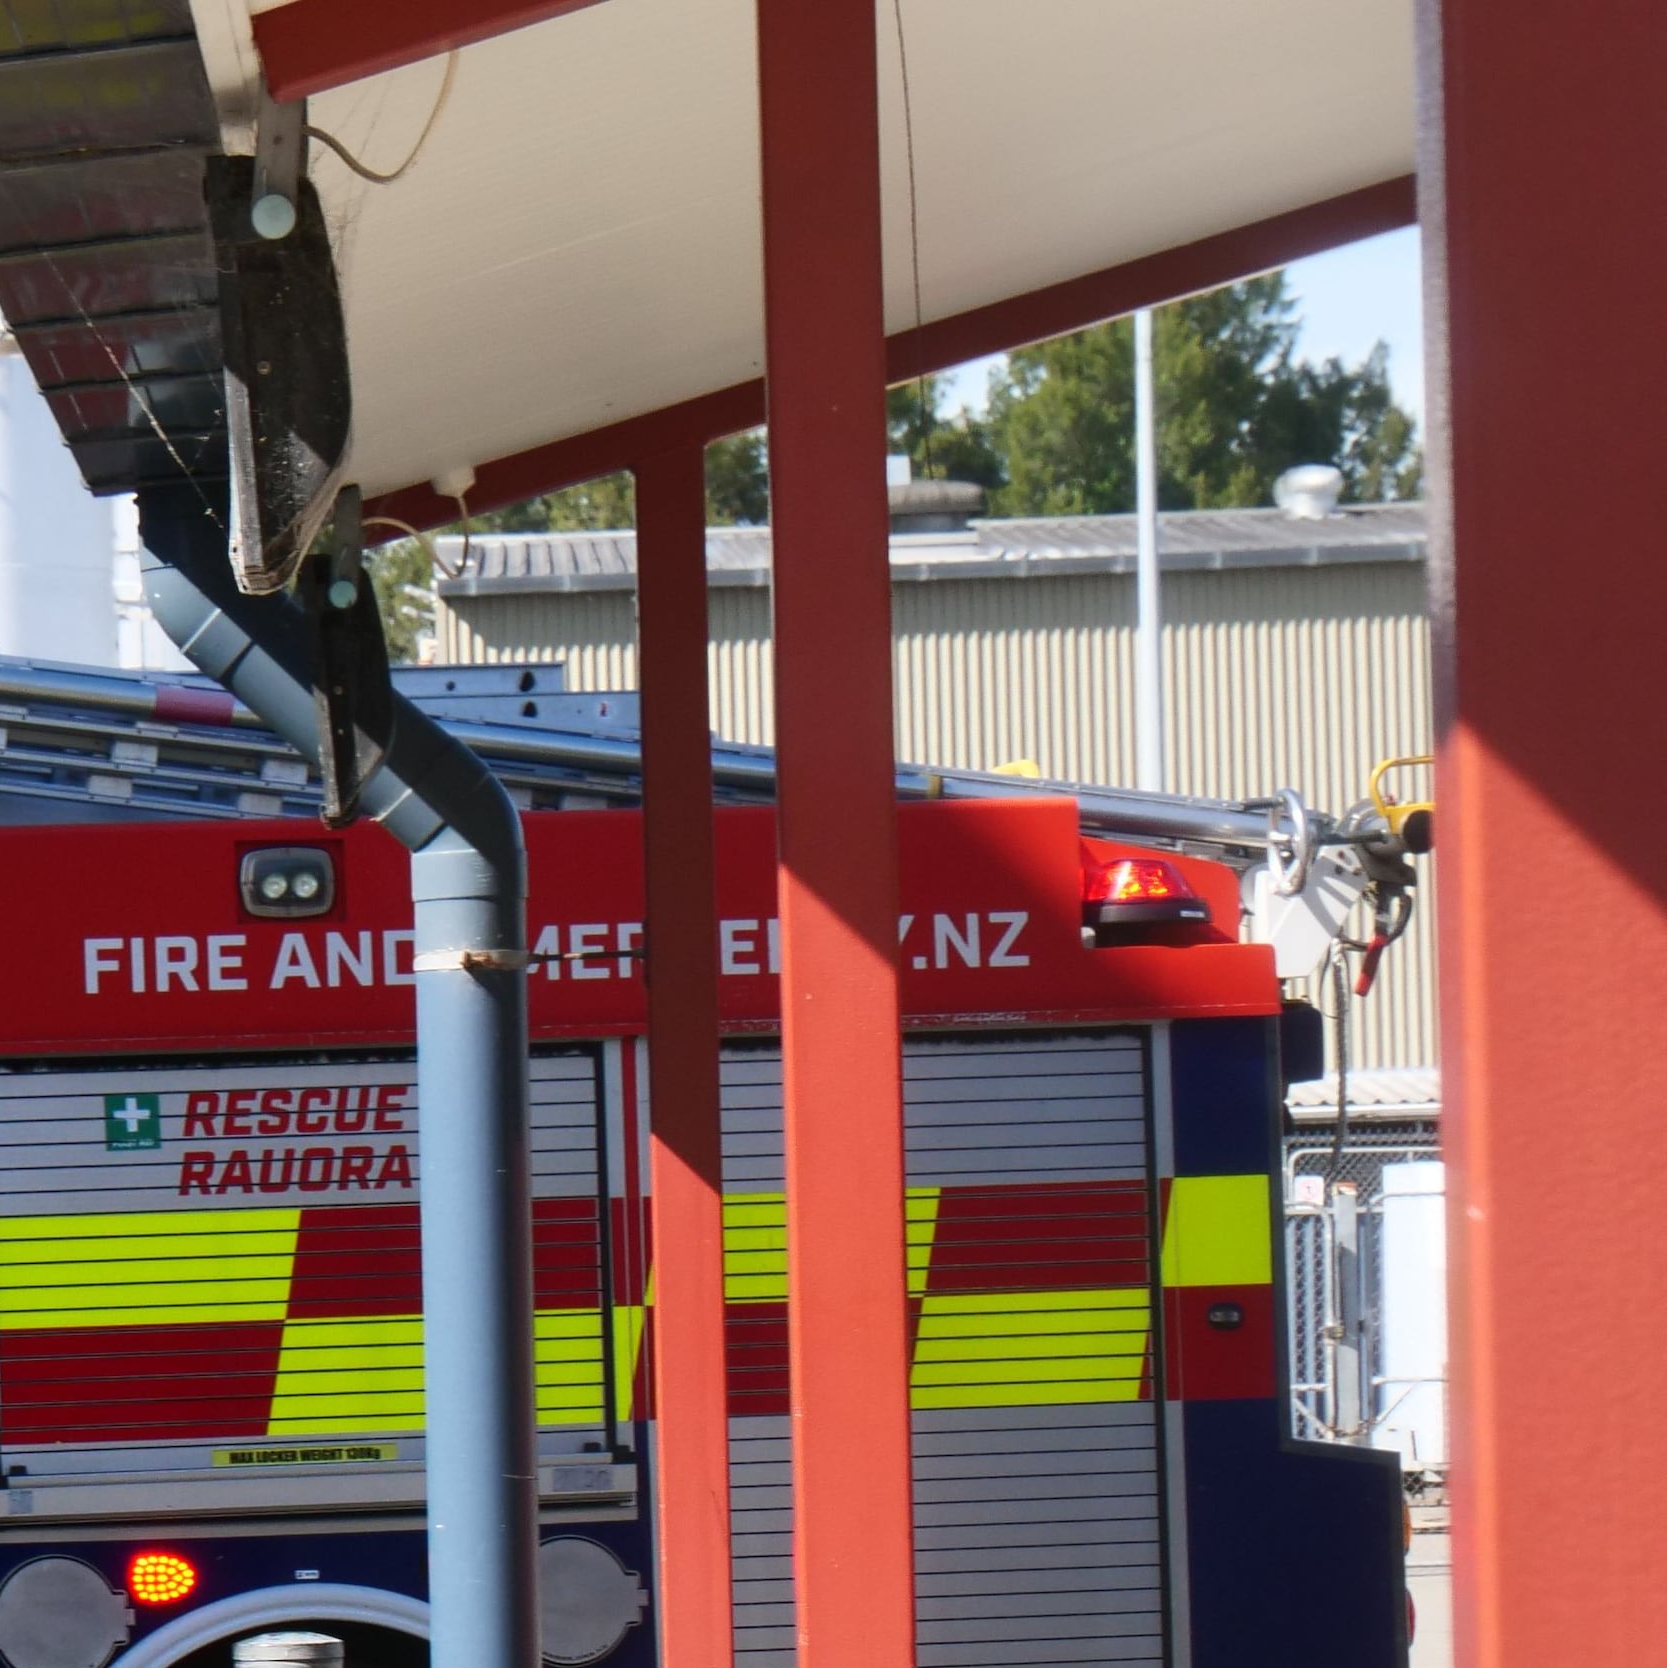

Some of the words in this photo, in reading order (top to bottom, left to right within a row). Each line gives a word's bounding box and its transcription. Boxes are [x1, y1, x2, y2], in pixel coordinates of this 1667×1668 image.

[84, 934, 248, 994] FIRE
[270, 930, 415, 989] AND
[183, 1086, 408, 1136] RESCUE
[178, 1145, 413, 1196] RAUORA
